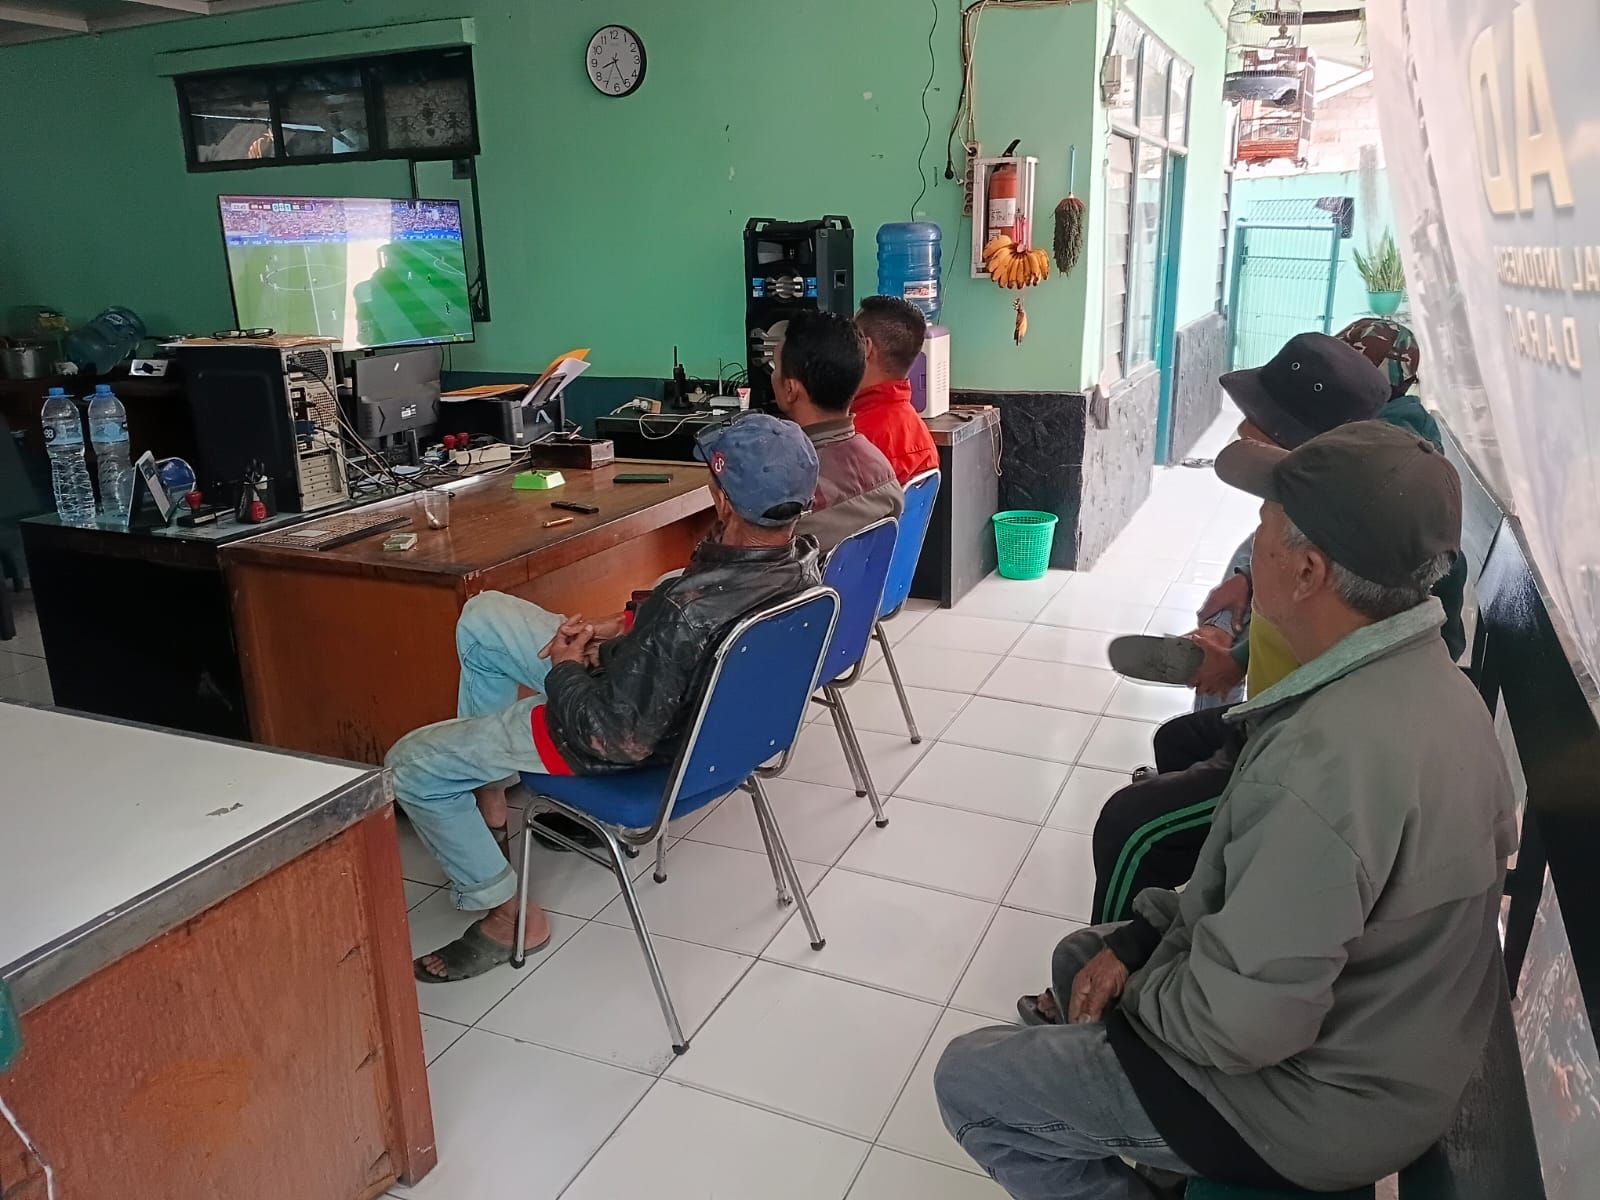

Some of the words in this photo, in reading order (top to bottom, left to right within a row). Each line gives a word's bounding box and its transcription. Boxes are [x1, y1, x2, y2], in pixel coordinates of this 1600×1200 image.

[610, 30, 619, 40] 12
[601, 36, 606, 44] 11
[593, 46, 602, 55] 10
[630, 42, 636, 52] 2
[592, 58, 598, 68] 9
[634, 55, 640, 64] 3
[596, 72, 602, 81] 8
[632, 70, 638, 79] 4
[602, 80, 608, 88] 7
[614, 82, 620, 92] 6
[624, 78, 630, 88] 5
